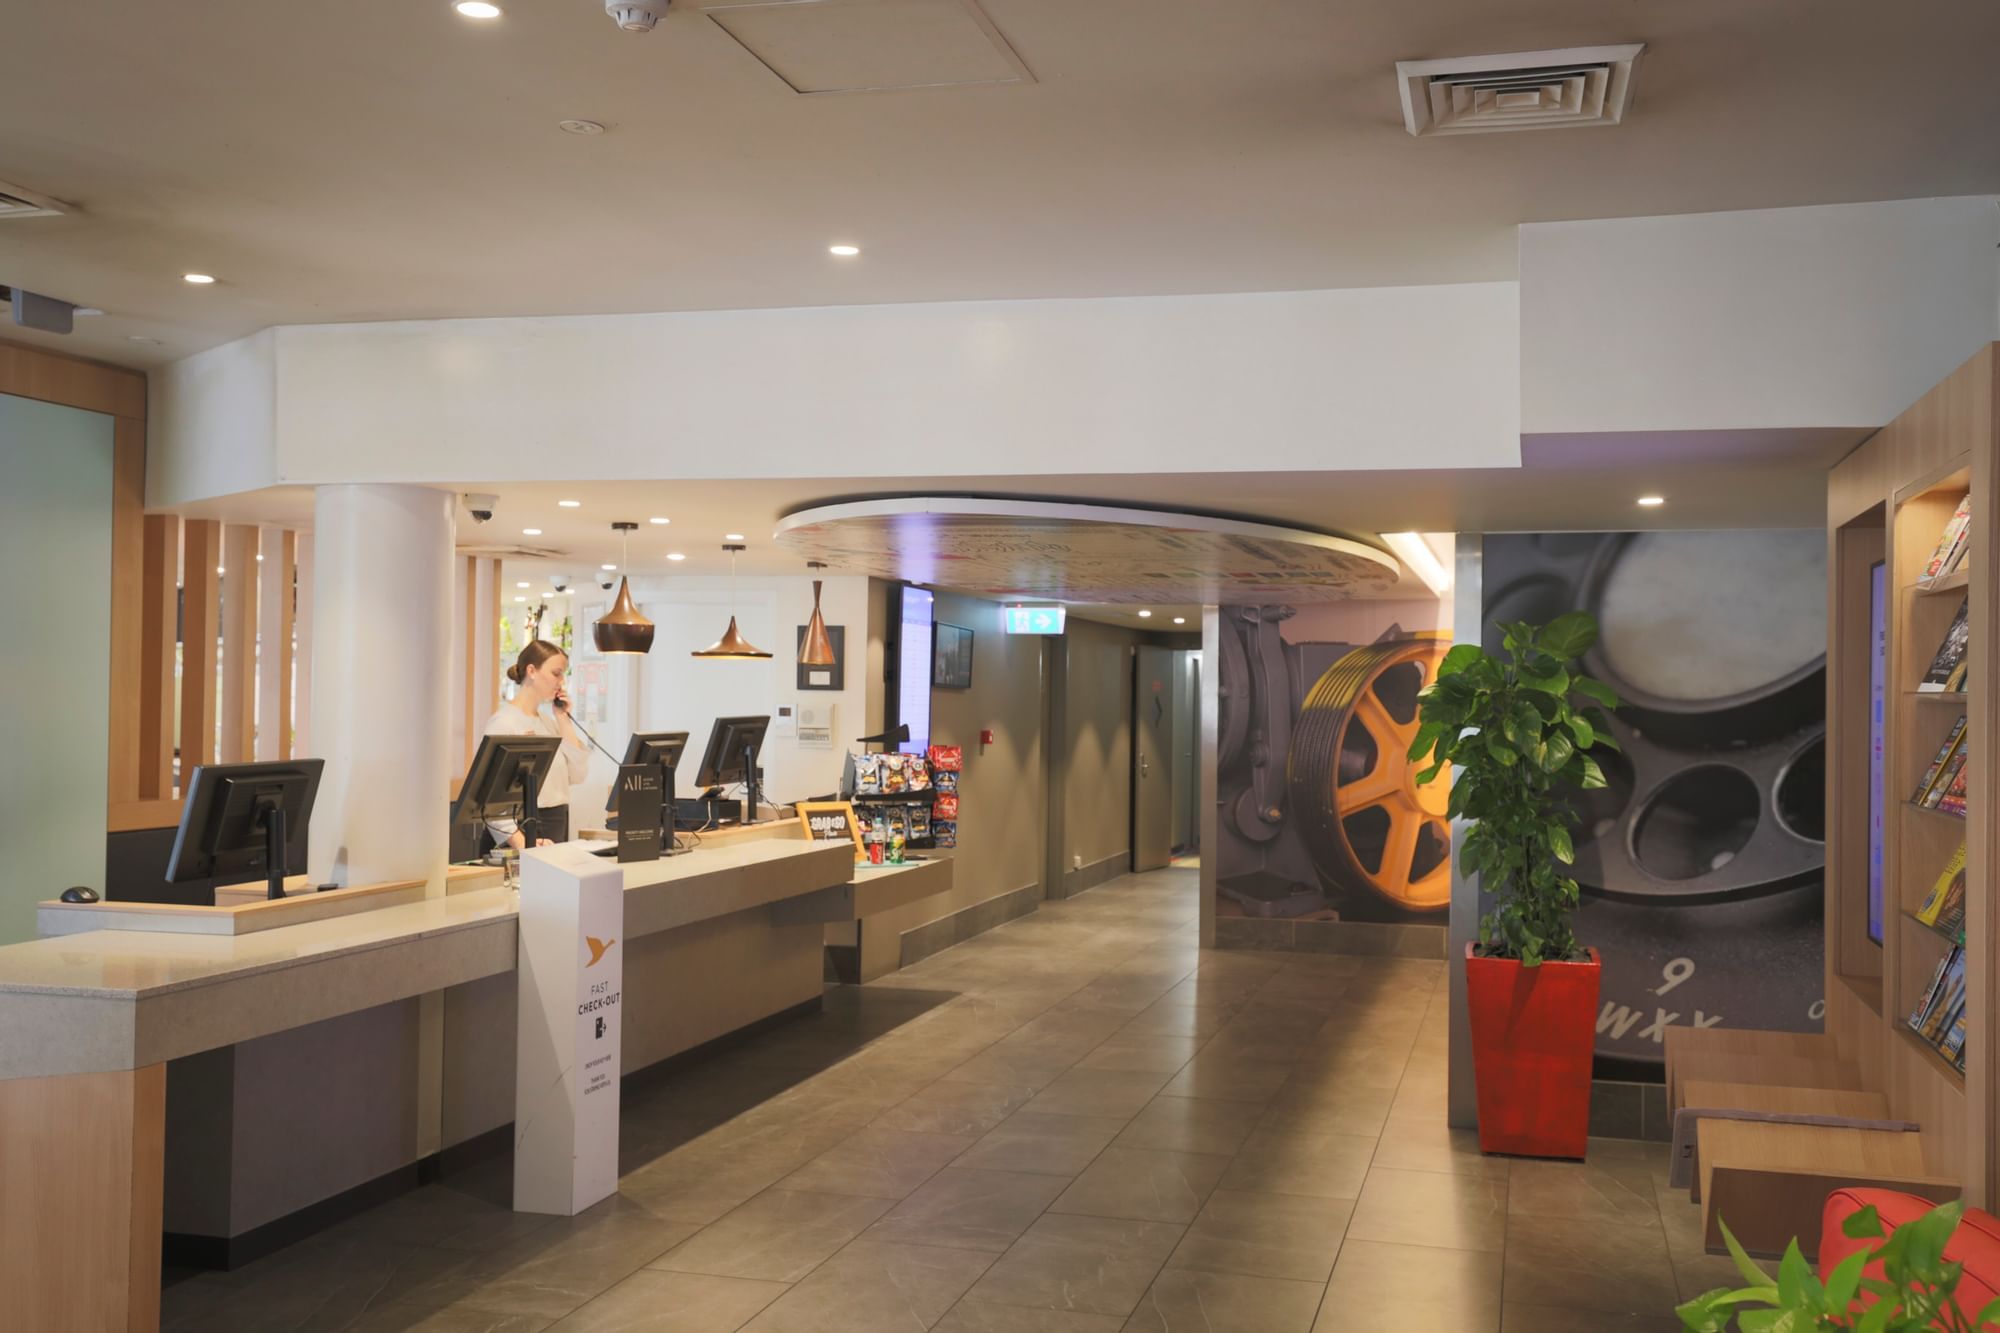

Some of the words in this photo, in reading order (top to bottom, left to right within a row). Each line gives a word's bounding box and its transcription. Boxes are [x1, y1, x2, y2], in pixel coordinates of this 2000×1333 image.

[591, 981, 608, 995] FAST
[1655, 957, 1695, 996] 9
[578, 992, 620, 1015] CHECK-OUT
